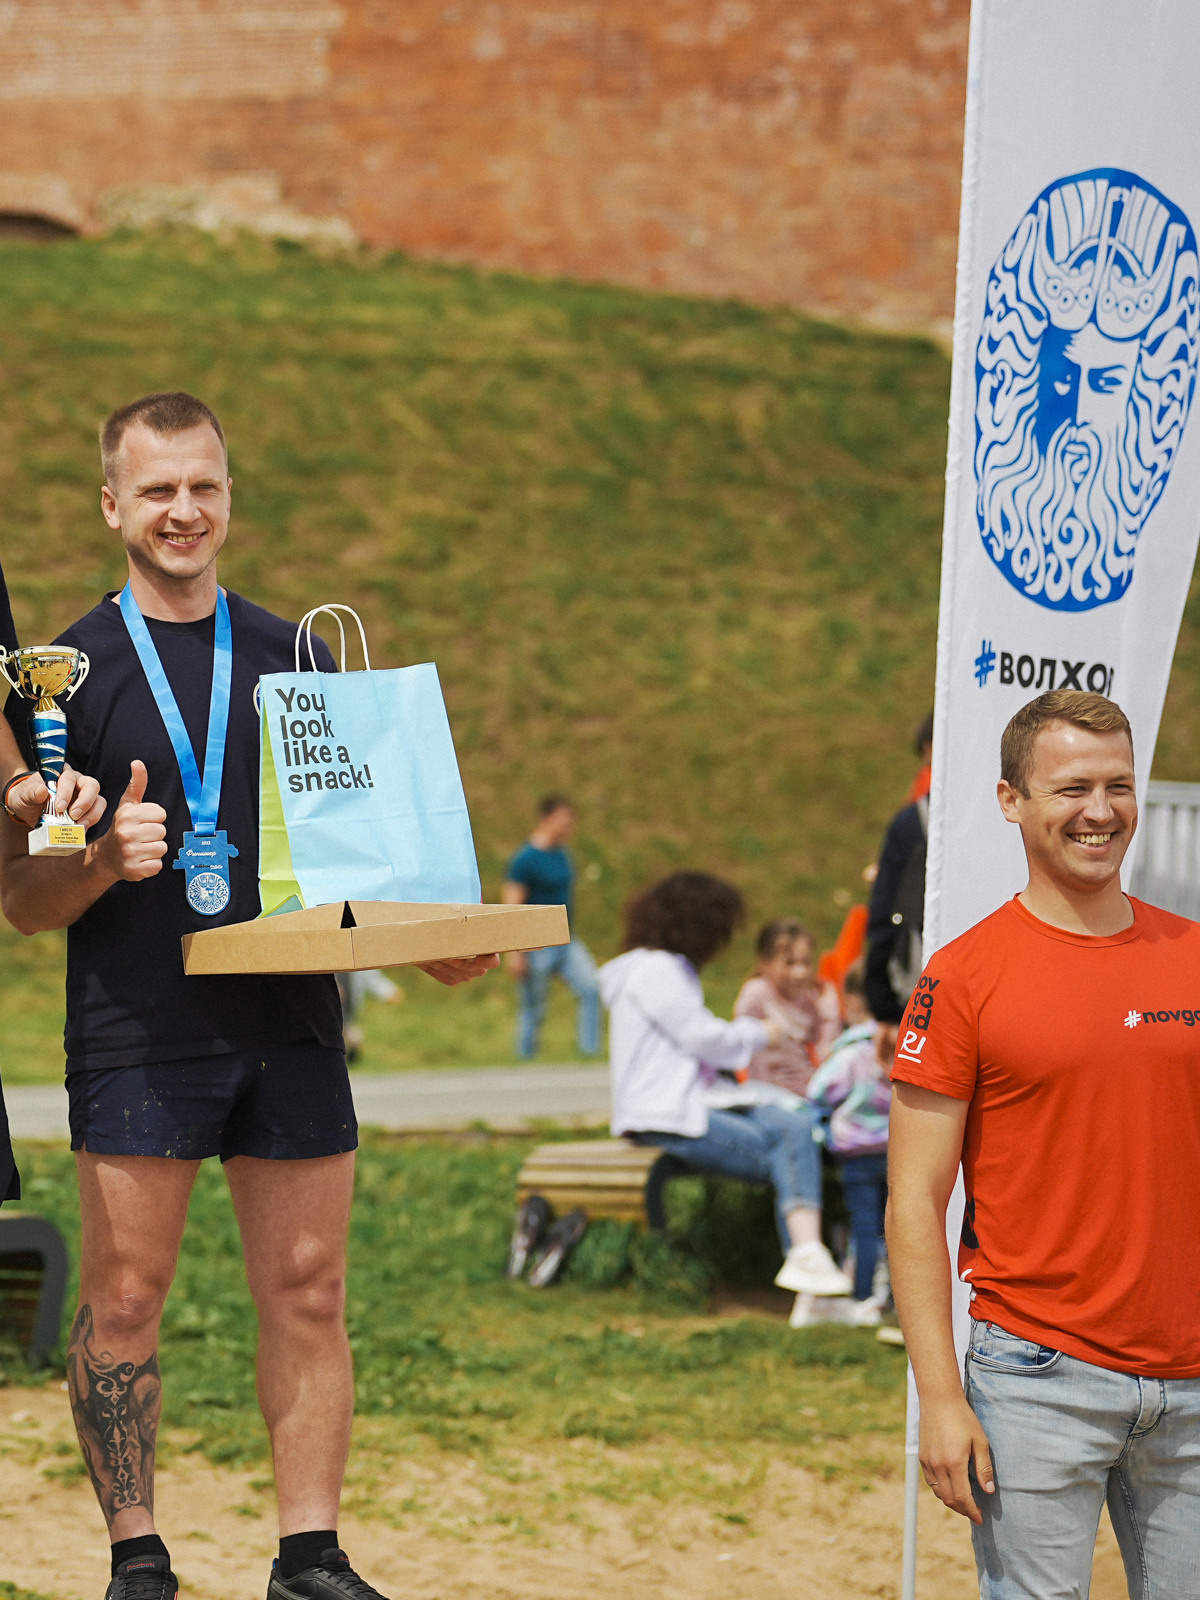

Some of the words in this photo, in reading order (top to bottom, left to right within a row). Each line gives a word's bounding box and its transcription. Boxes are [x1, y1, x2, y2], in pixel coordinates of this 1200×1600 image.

[275, 687, 326, 713] You
[280, 712, 335, 740] look
[283, 739, 333, 767] like
[336, 745, 351, 764] a
[288, 764, 374, 793] snack!
